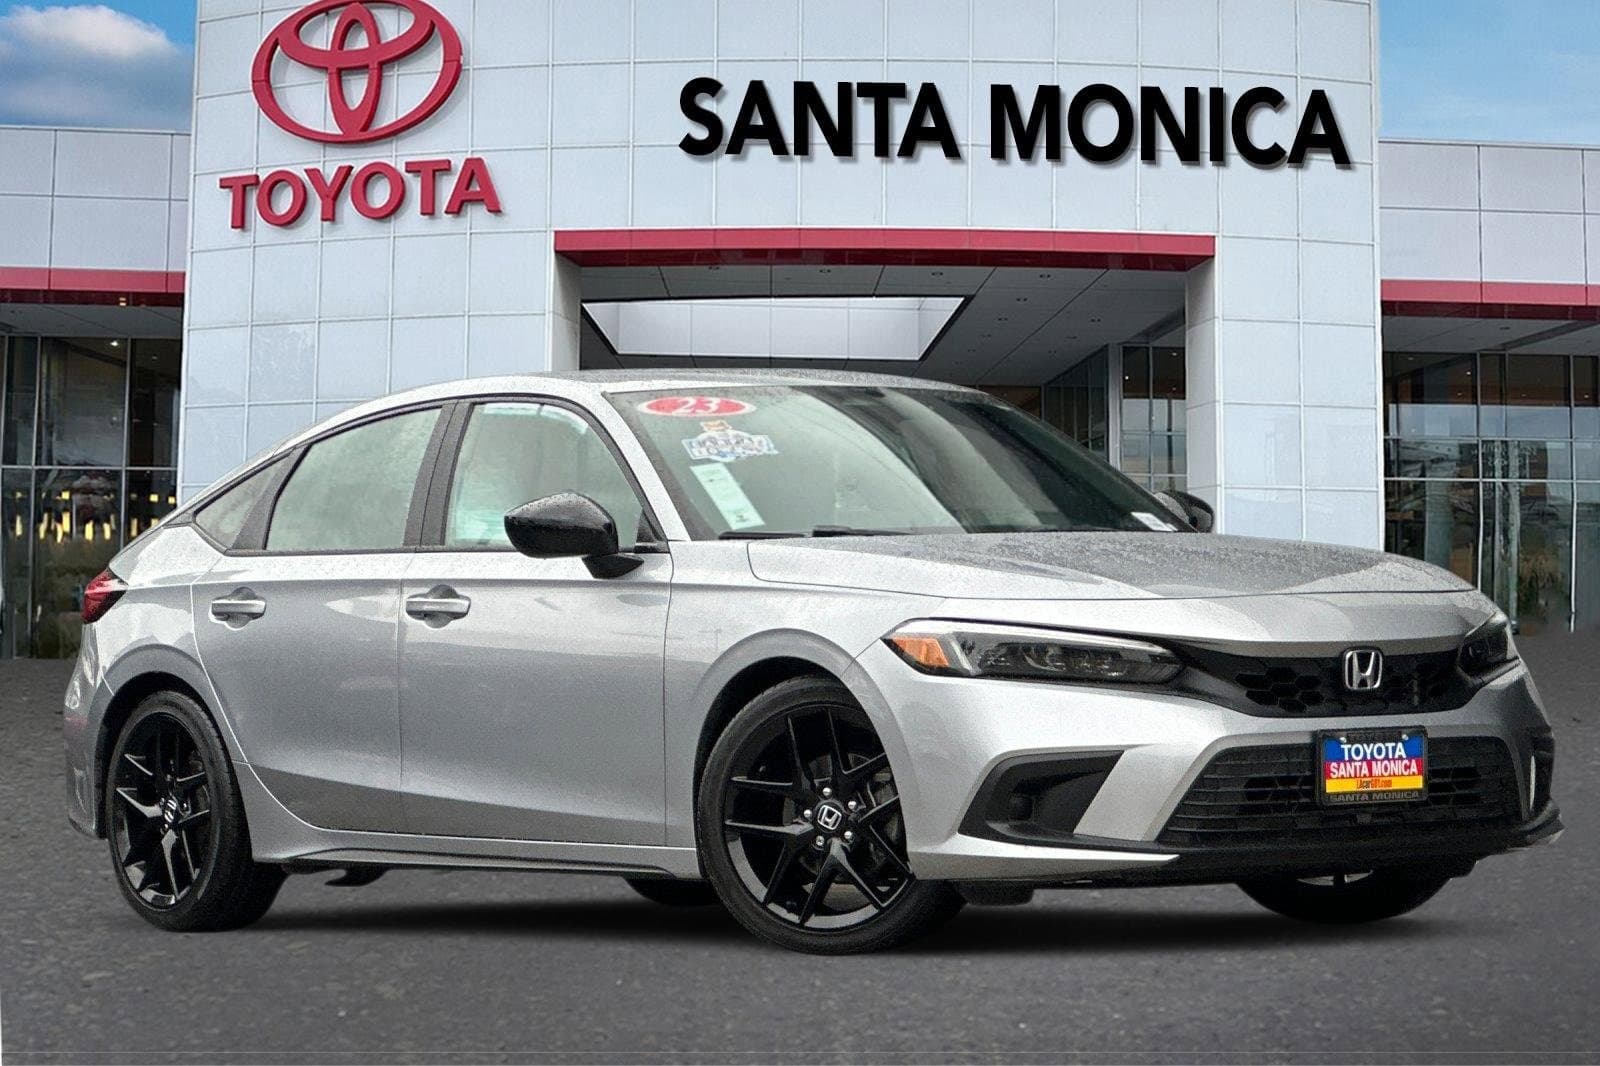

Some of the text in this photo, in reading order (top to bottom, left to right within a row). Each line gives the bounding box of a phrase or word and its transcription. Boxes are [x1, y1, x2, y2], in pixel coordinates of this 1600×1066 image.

[678, 76, 1352, 170] SANTA MONICA
[219, 157, 502, 229] TOYOTA
[672, 397, 720, 415] 23
[1340, 742, 1407, 761] TOYOTA
[1330, 759, 1418, 778] SANTA MONICA
